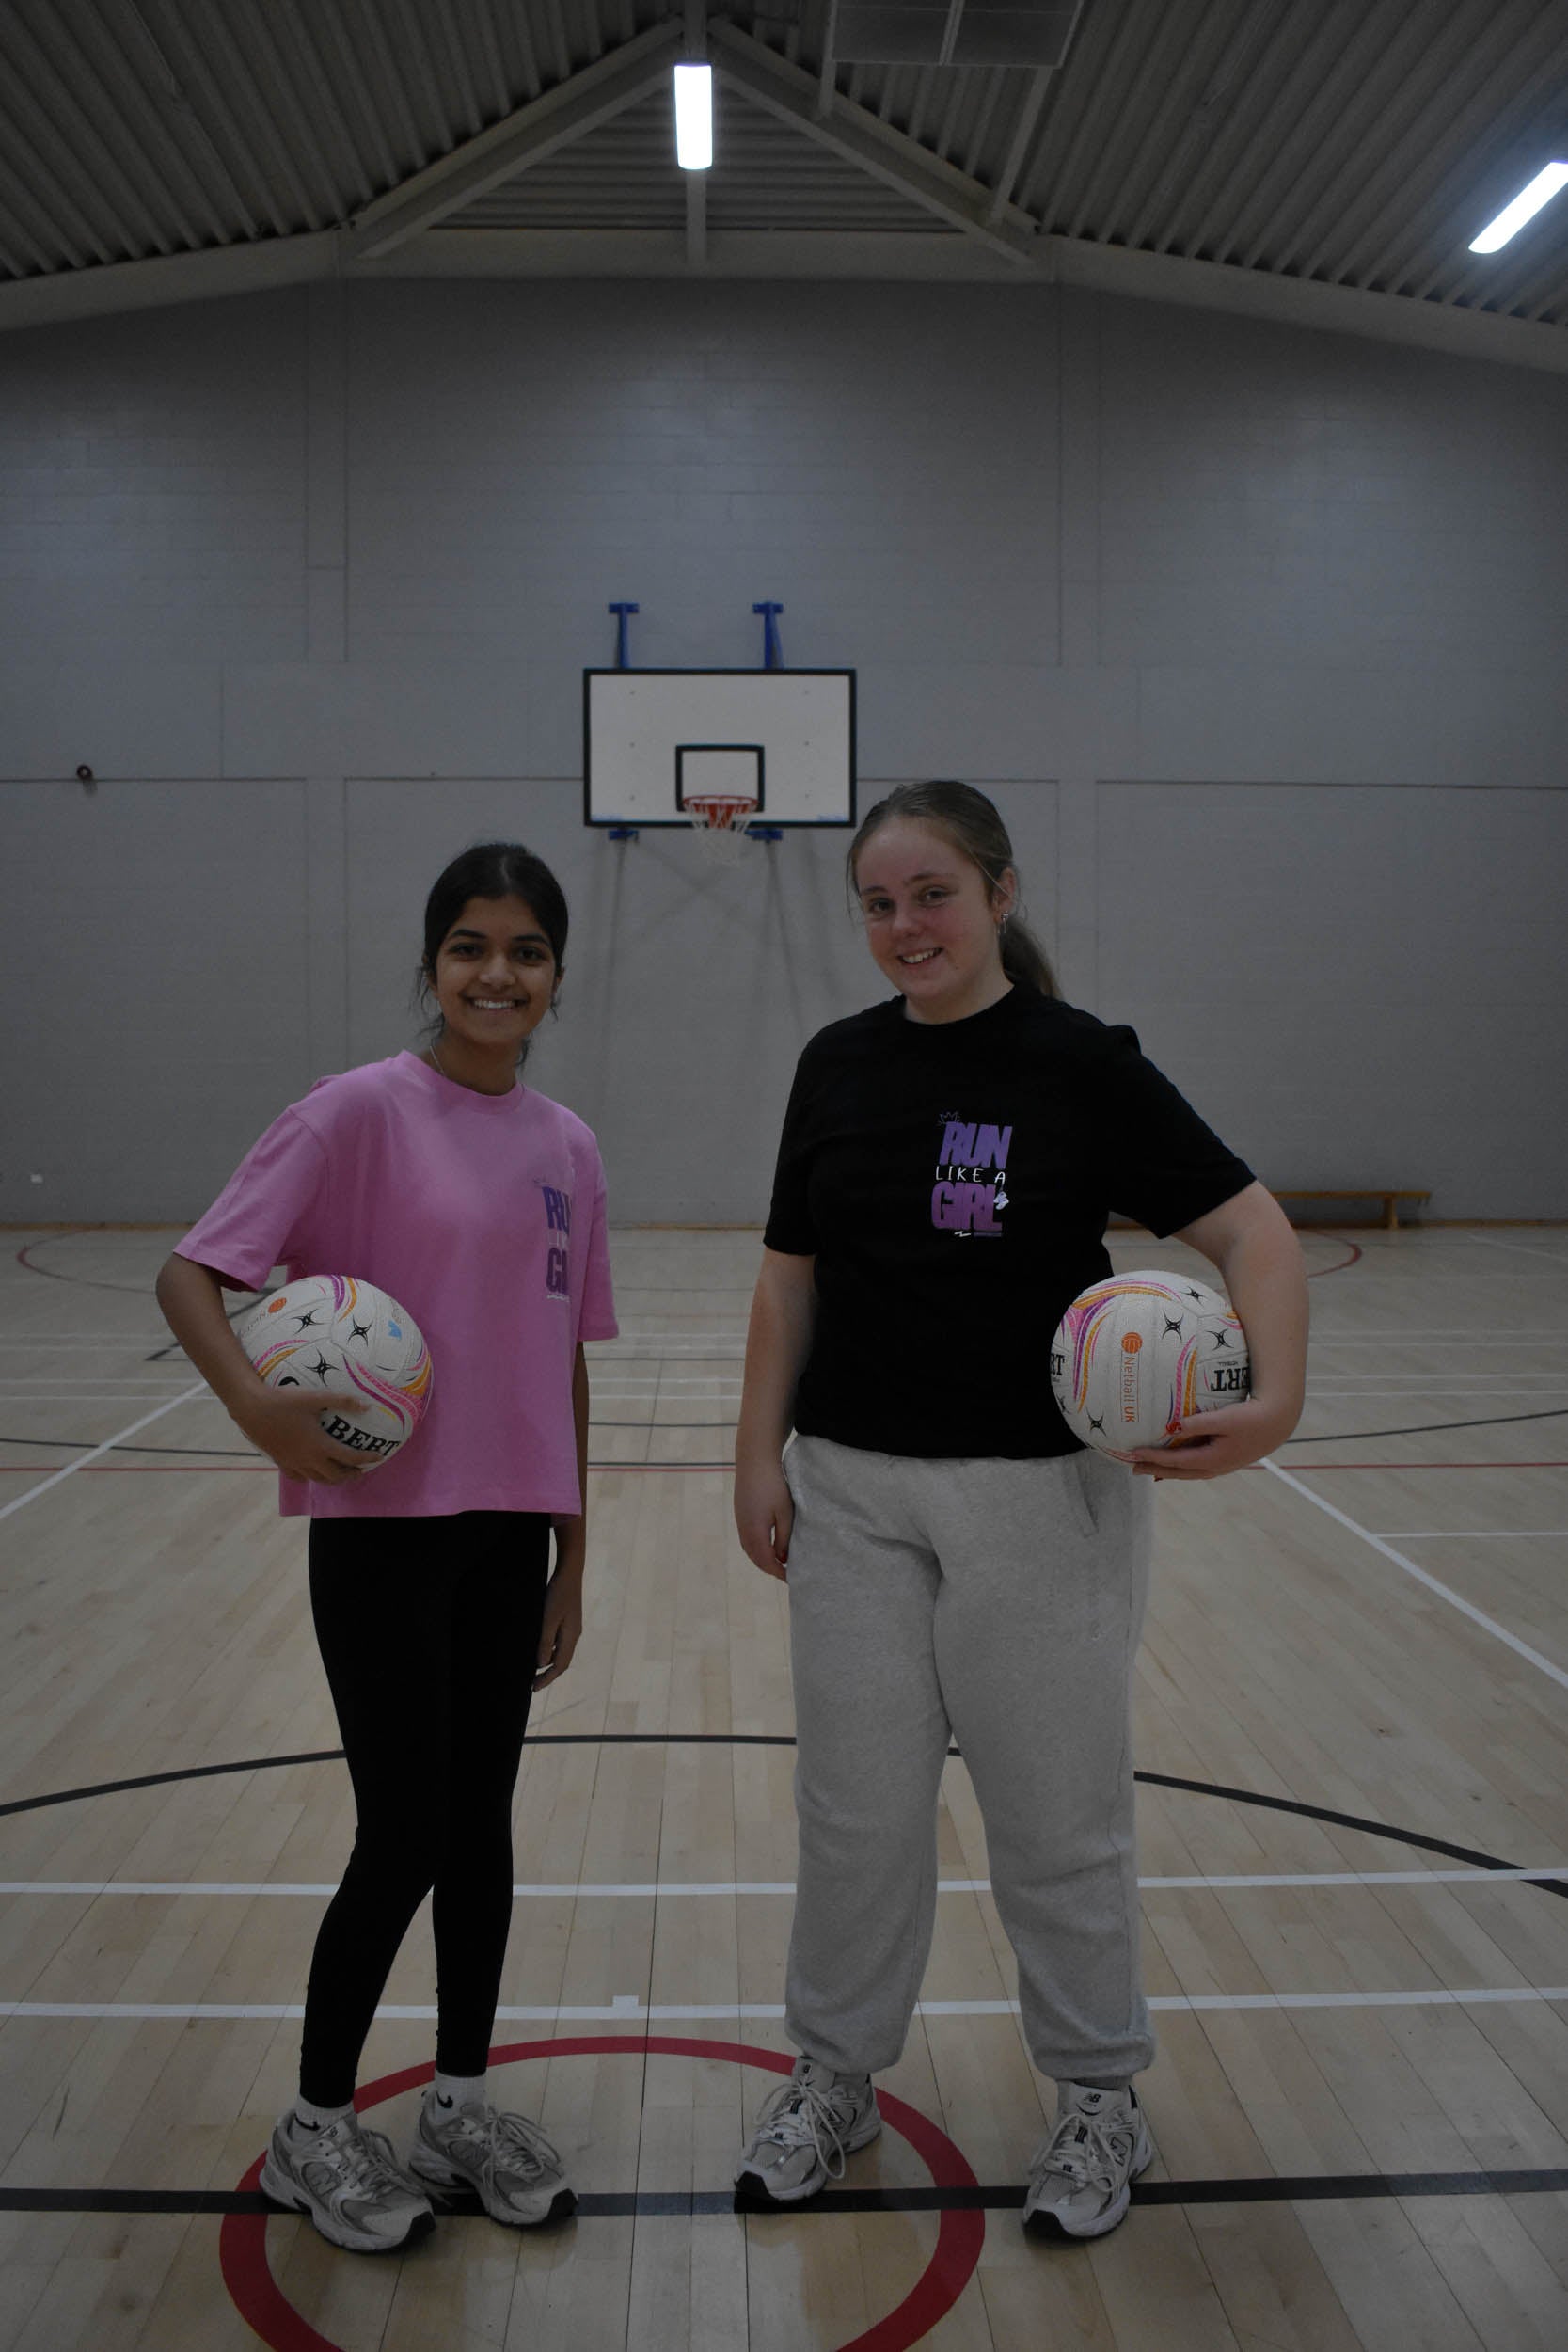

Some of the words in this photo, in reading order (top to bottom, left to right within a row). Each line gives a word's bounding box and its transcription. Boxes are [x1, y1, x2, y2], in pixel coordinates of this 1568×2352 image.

[939, 1121, 1013, 1170] RUN
[935, 1166, 984, 1183] LIKE
[993, 1170, 1006, 1190] A
[542, 1186, 572, 1236] RU
[931, 1180, 1003, 1232] GIRL
[546, 1248, 568, 1295] GI
[1123, 1356, 1135, 1403] Netball
[322, 1415, 401, 1456] BERT
[1124, 1406, 1136, 1422] UK
